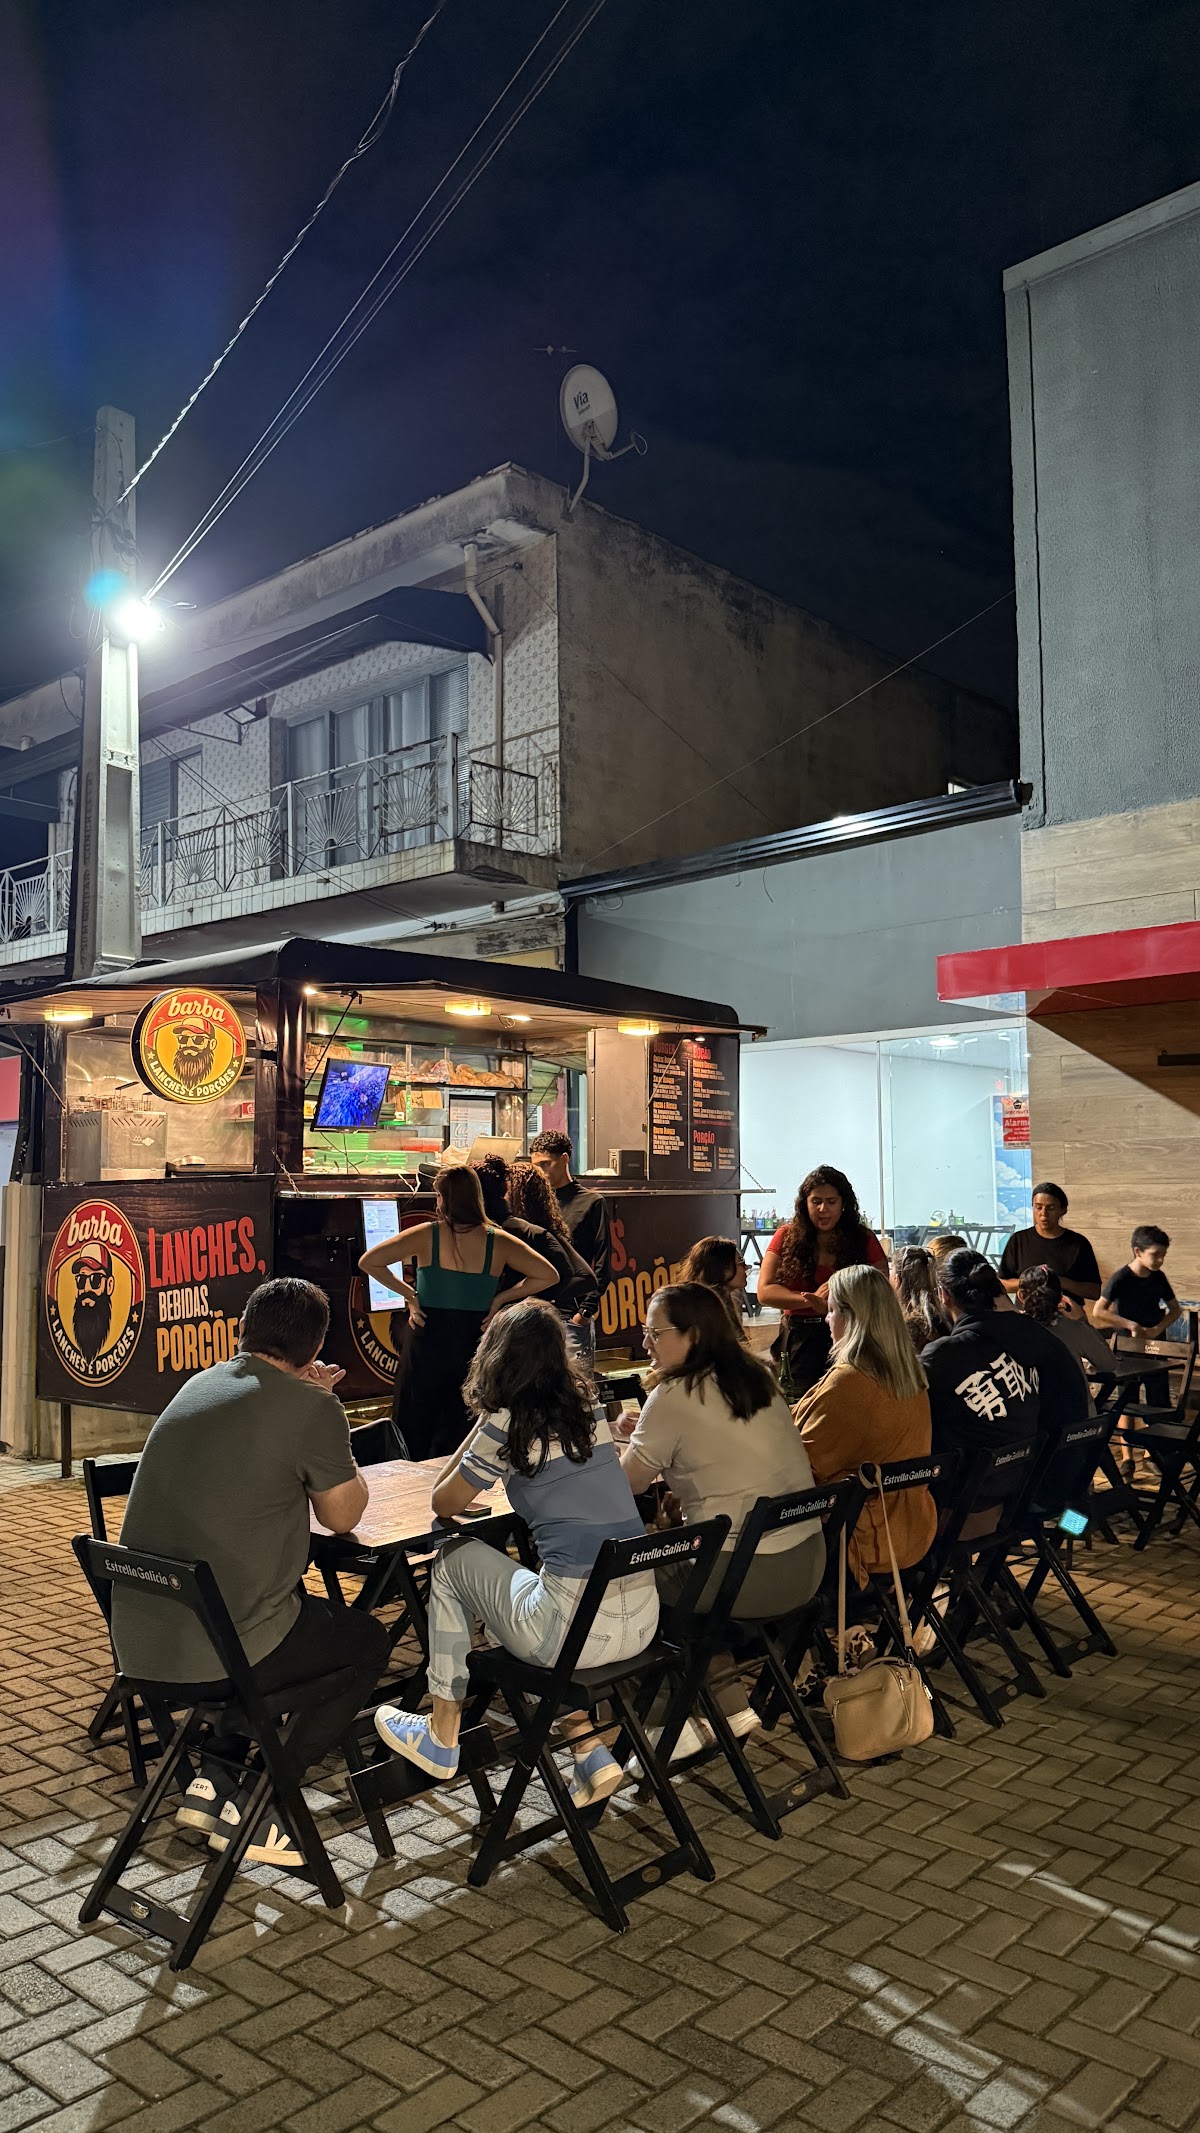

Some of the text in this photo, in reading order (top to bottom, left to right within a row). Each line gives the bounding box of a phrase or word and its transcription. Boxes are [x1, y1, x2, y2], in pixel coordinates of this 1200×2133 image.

[573, 391, 589, 410] Via
[167, 996, 226, 1022] barba
[149, 1060, 236, 1097] LANCHES E PORÇÕES
[67, 1209, 124, 1248] barba
[148, 1216, 266, 1289] LANCHES,
[158, 1284, 214, 1323] BEBIDAS,
[51, 1318, 135, 1375] LANCHES E PORÇÕES
[156, 1309, 239, 1373] PORÇÕE
[192, 1782, 209, 1792] VERT
